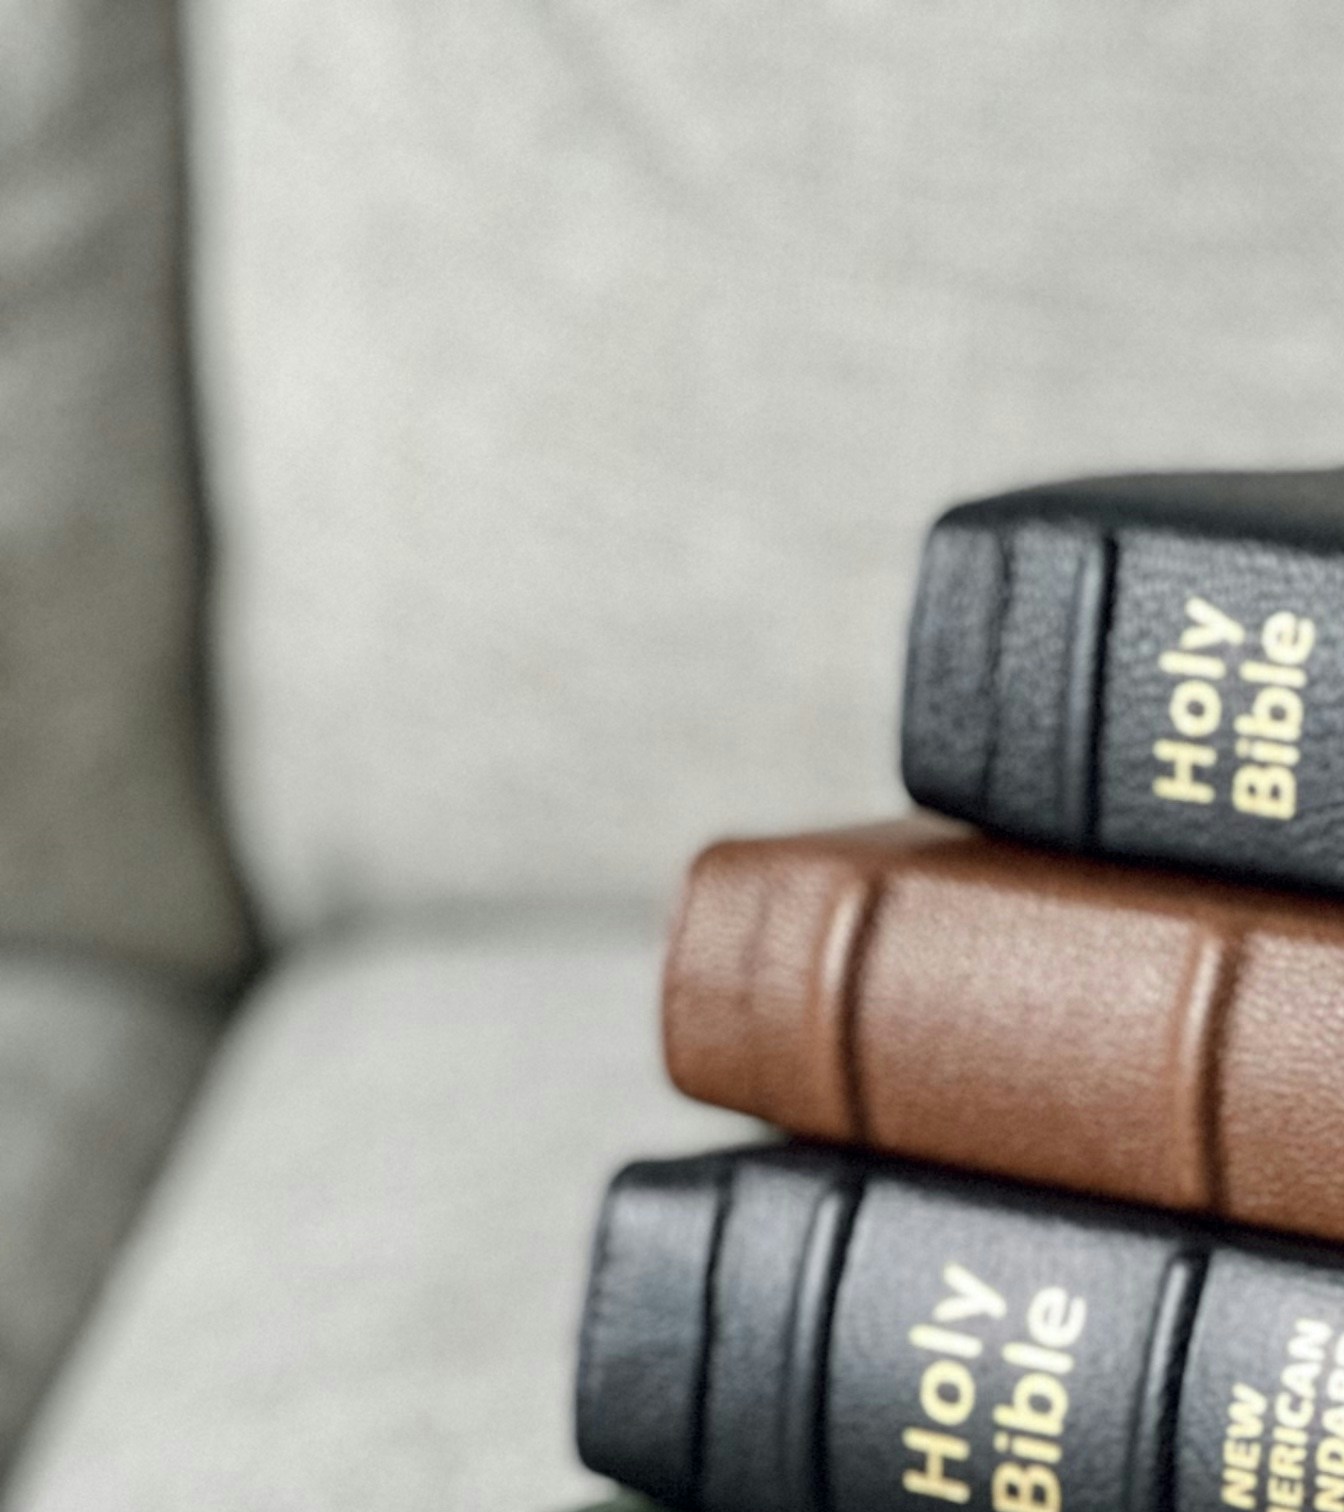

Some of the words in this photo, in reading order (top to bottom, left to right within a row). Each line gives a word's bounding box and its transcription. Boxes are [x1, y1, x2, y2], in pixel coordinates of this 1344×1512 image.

[1153, 597, 1246, 803] Holy
[1231, 610, 1317, 820] Bible
[902, 1263, 1007, 1503] Holy
[1221, 1383, 1267, 1510] NEW
